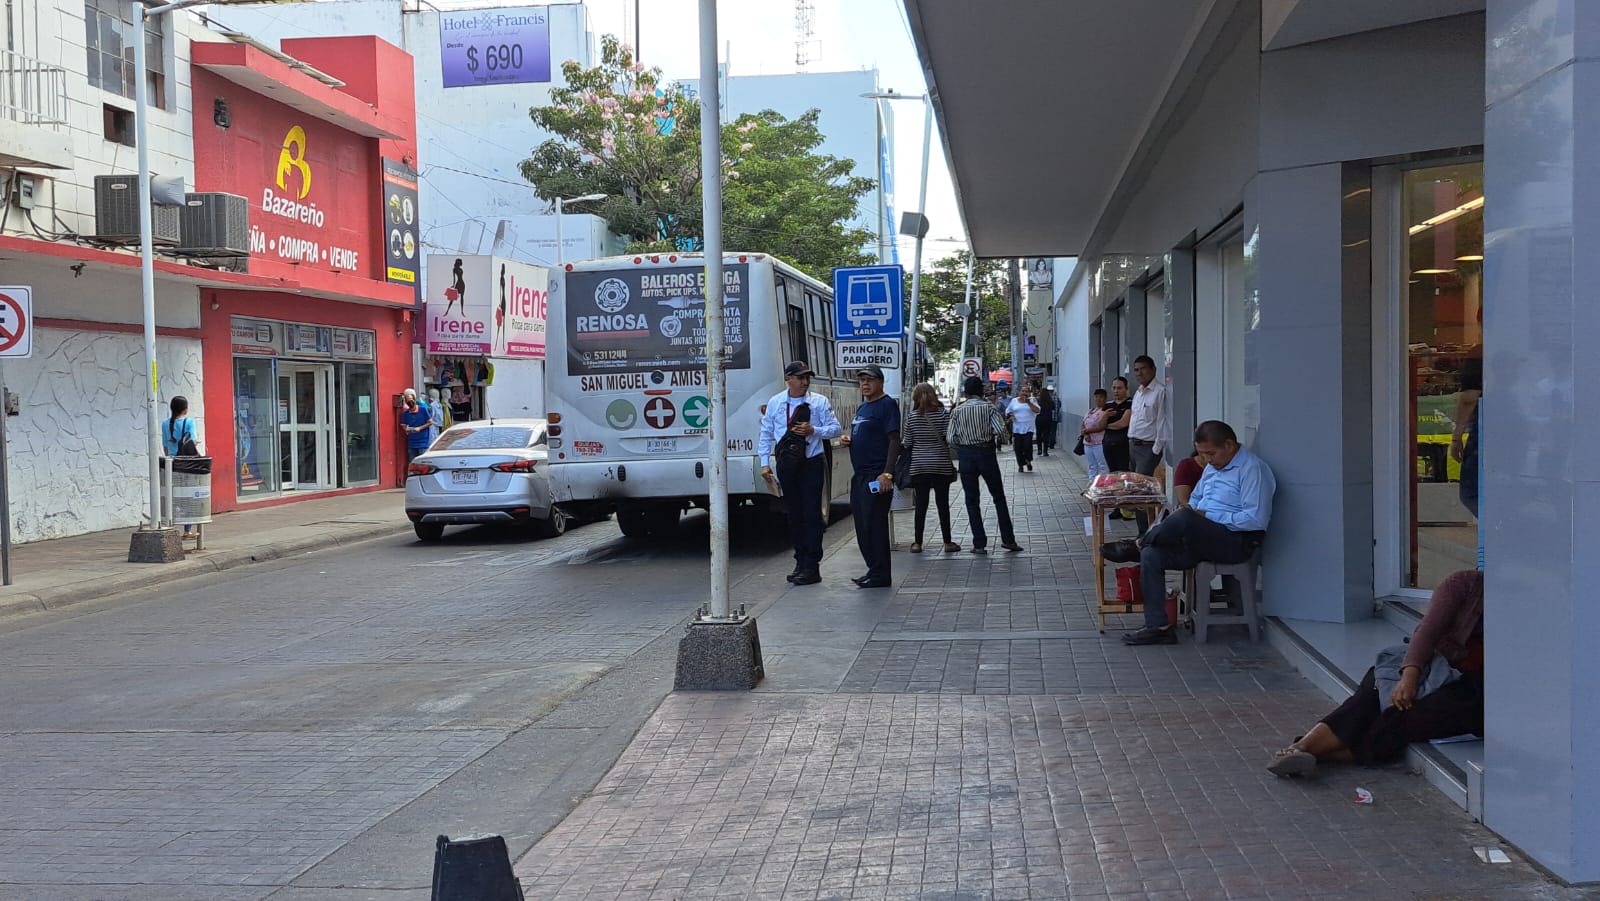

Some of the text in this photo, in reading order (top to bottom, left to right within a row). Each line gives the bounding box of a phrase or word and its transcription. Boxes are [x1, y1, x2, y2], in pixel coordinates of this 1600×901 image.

[444, 13, 545, 30] Hotel Francis
[466, 43, 523, 75] $ 690
[263, 187, 325, 228] Bazareño
[278, 235, 319, 264] COMPRA
[329, 246, 359, 271] VENDE
[641, 273, 695, 289] BALEROS
[510, 275, 548, 321] Irene
[641, 289, 666, 298] AUTOS,
[666, 288, 682, 296] PICK
[683, 287, 698, 295] UPS,
[726, 285, 740, 294] RZR
[434, 316, 485, 334] Irene
[576, 314, 649, 332] RENOSA
[698, 318, 703, 327] Y
[692, 326, 741, 337] TOD DE
[670, 337, 693, 346] JUNTAS
[842, 345, 894, 354] PRINCIPIA
[594, 349, 627, 360] 5311244
[843, 356, 893, 364] PARADERO
[581, 371, 709, 392] SAN MIGUEL AMIST
[727, 439, 753, 451] 441-10
